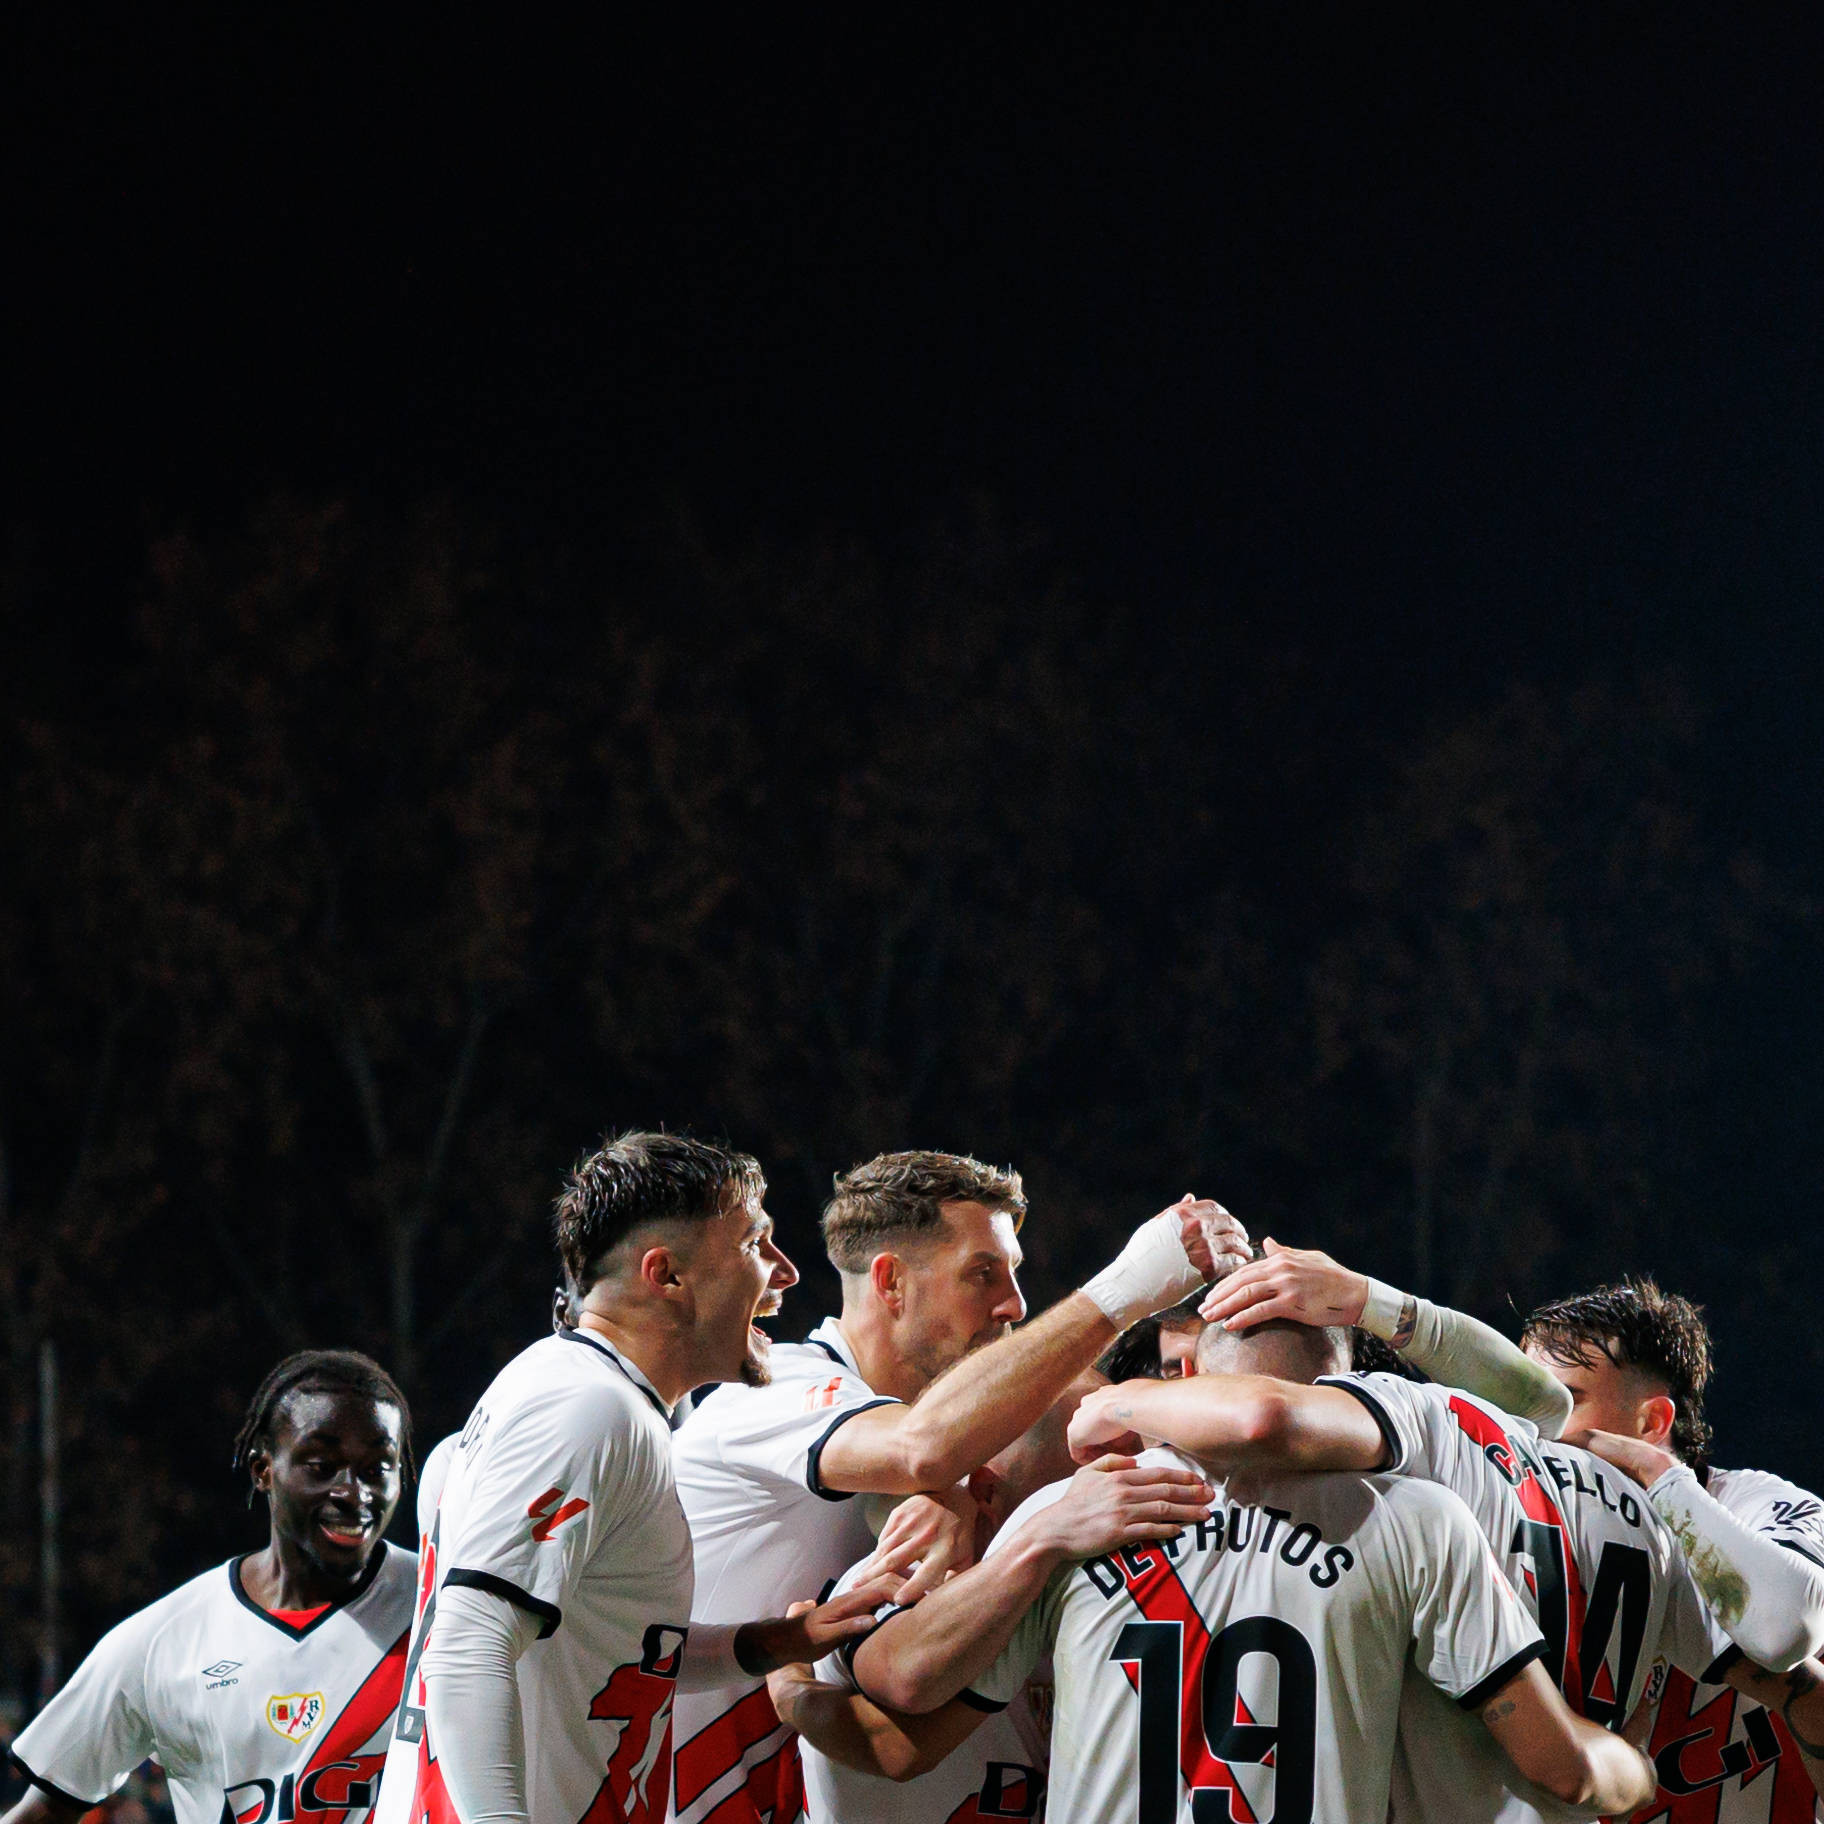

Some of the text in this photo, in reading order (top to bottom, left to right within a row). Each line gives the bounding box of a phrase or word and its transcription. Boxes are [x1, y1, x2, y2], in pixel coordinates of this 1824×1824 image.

[1485, 1434, 1641, 1528] CAELLO
[1509, 1518, 1651, 1730] 14
[206, 1678, 239, 1690] umbro
